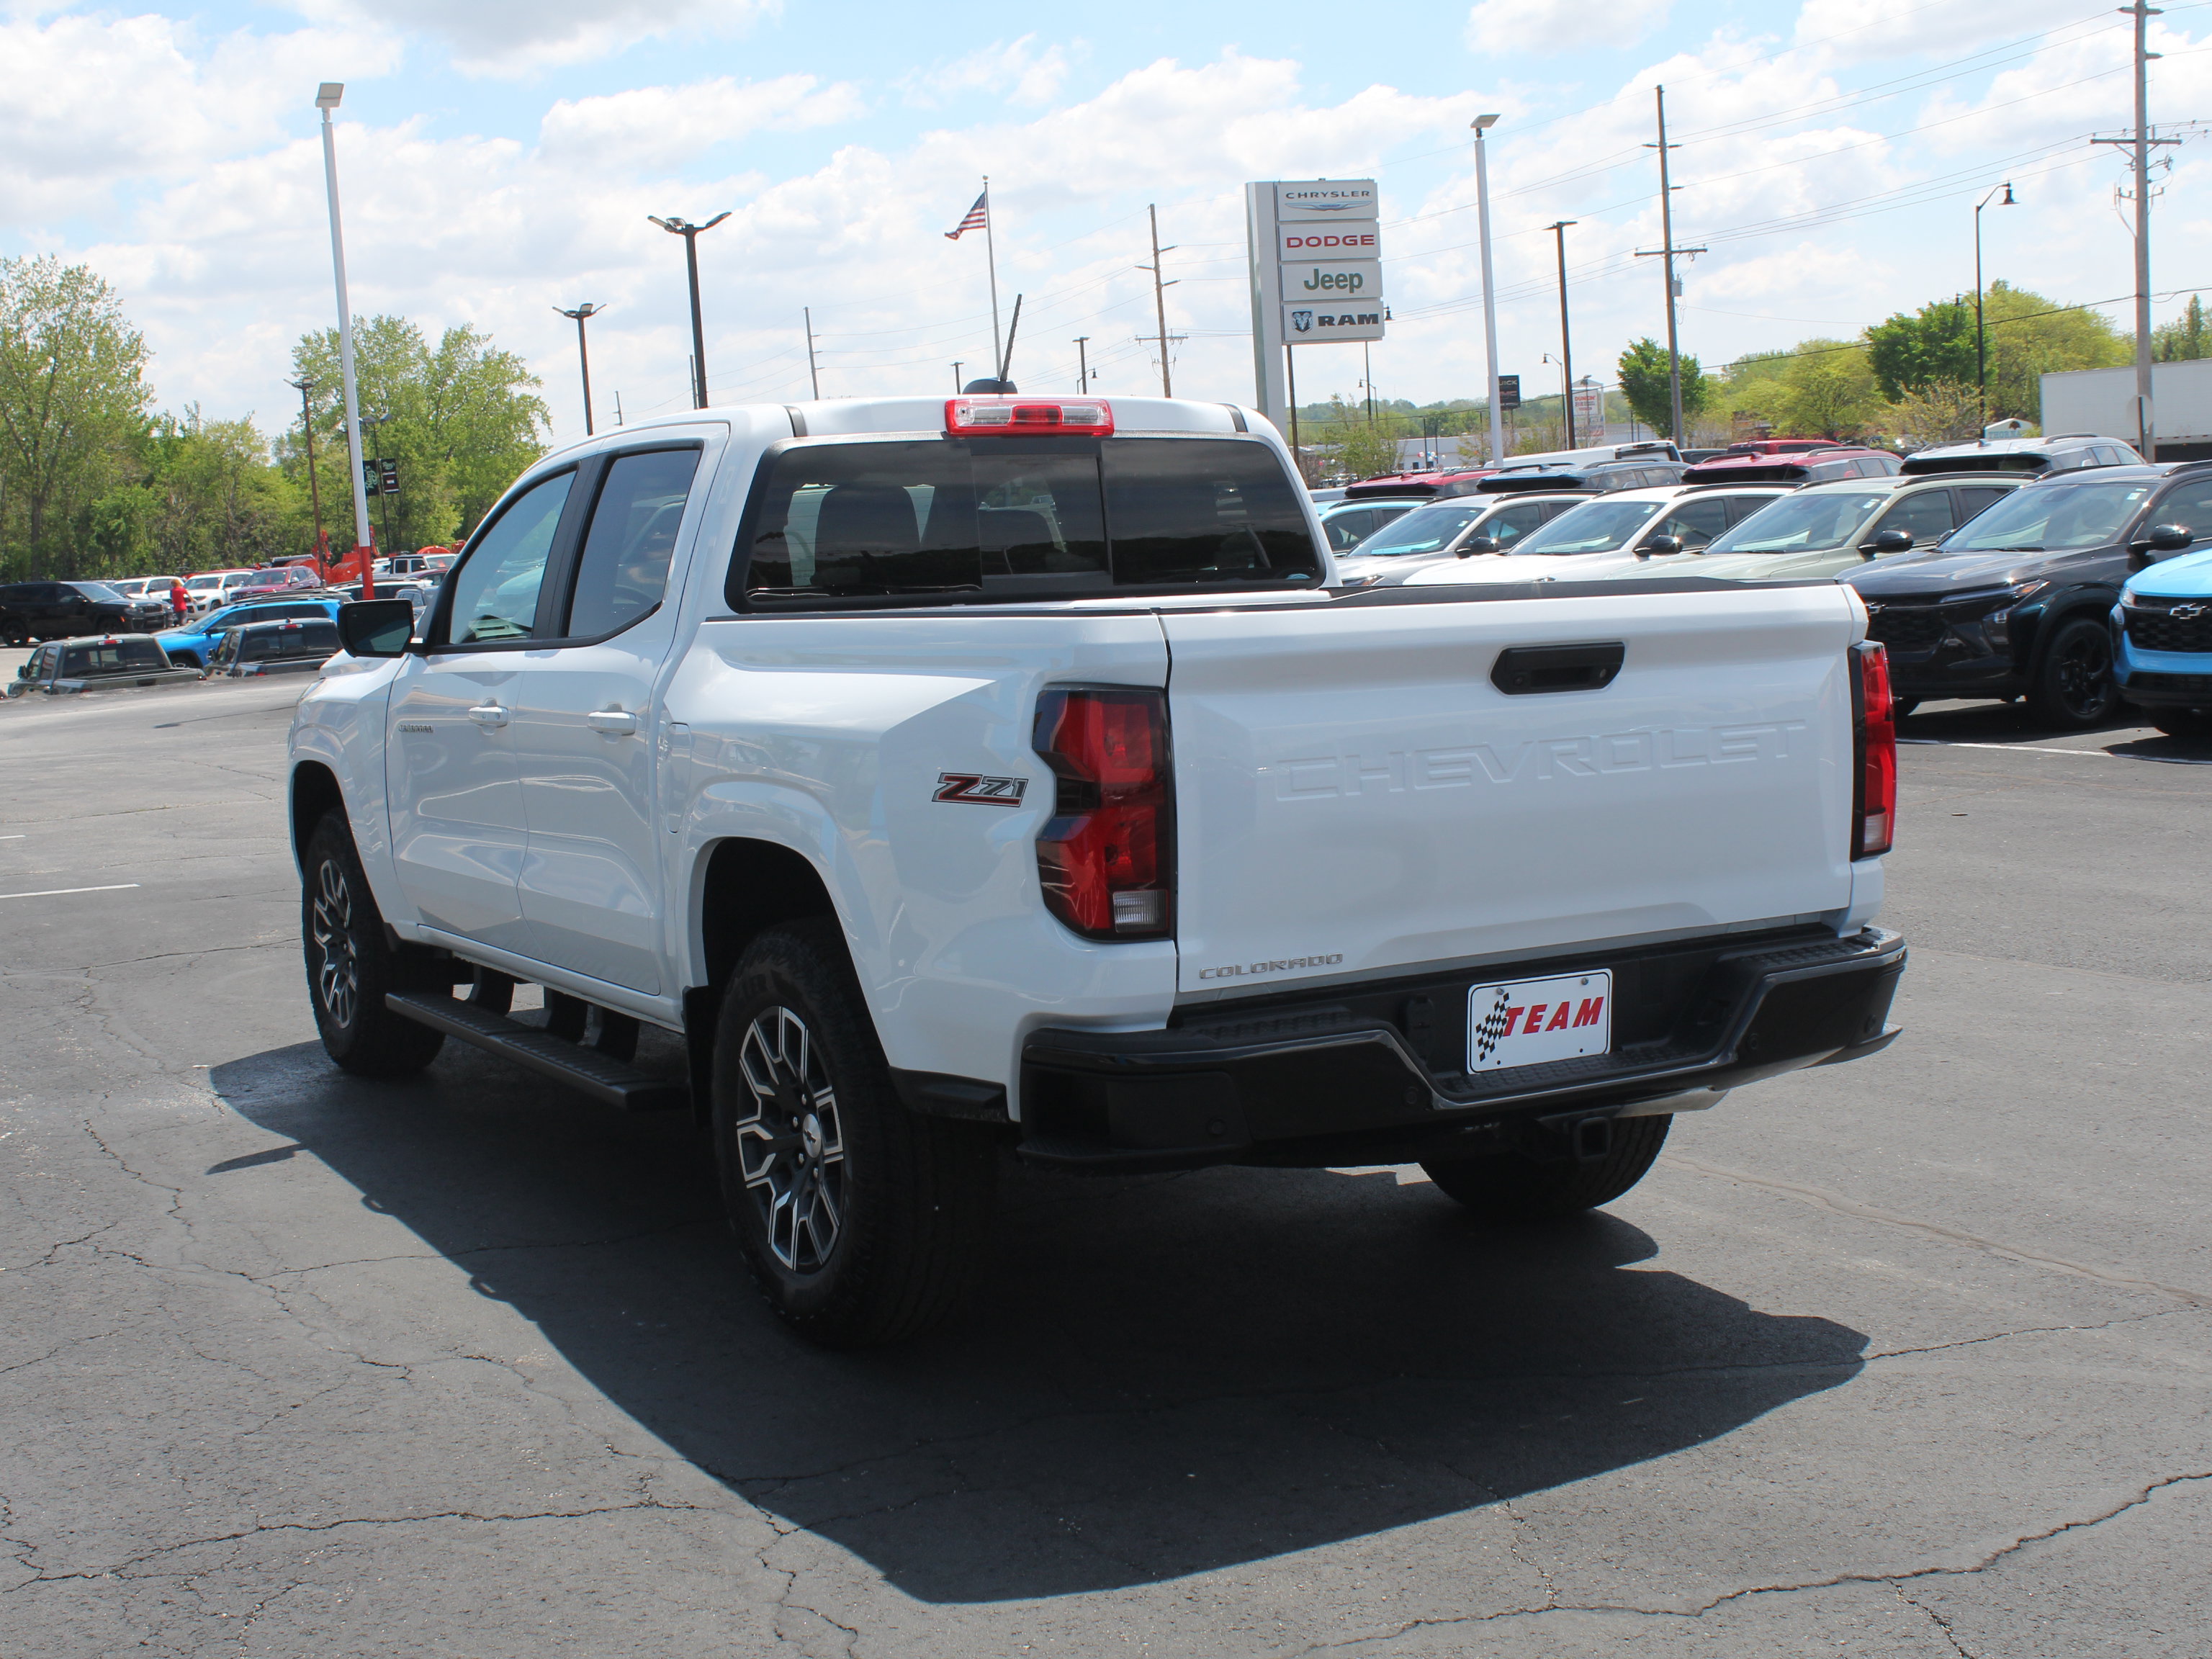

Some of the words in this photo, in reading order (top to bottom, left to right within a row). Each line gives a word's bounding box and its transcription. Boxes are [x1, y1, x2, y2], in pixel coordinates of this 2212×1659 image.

[1285, 190, 1370, 199] CHRYSLER
[1287, 234, 1375, 248] DODGE
[1304, 268, 1363, 294] Jeep
[1318, 313, 1380, 327] RAM
[1275, 719, 1807, 802] CHEVROLET
[932, 772, 1029, 808] Z71
[1199, 953, 1344, 979] COLORADO
[1502, 996, 1605, 1037] TEAM
